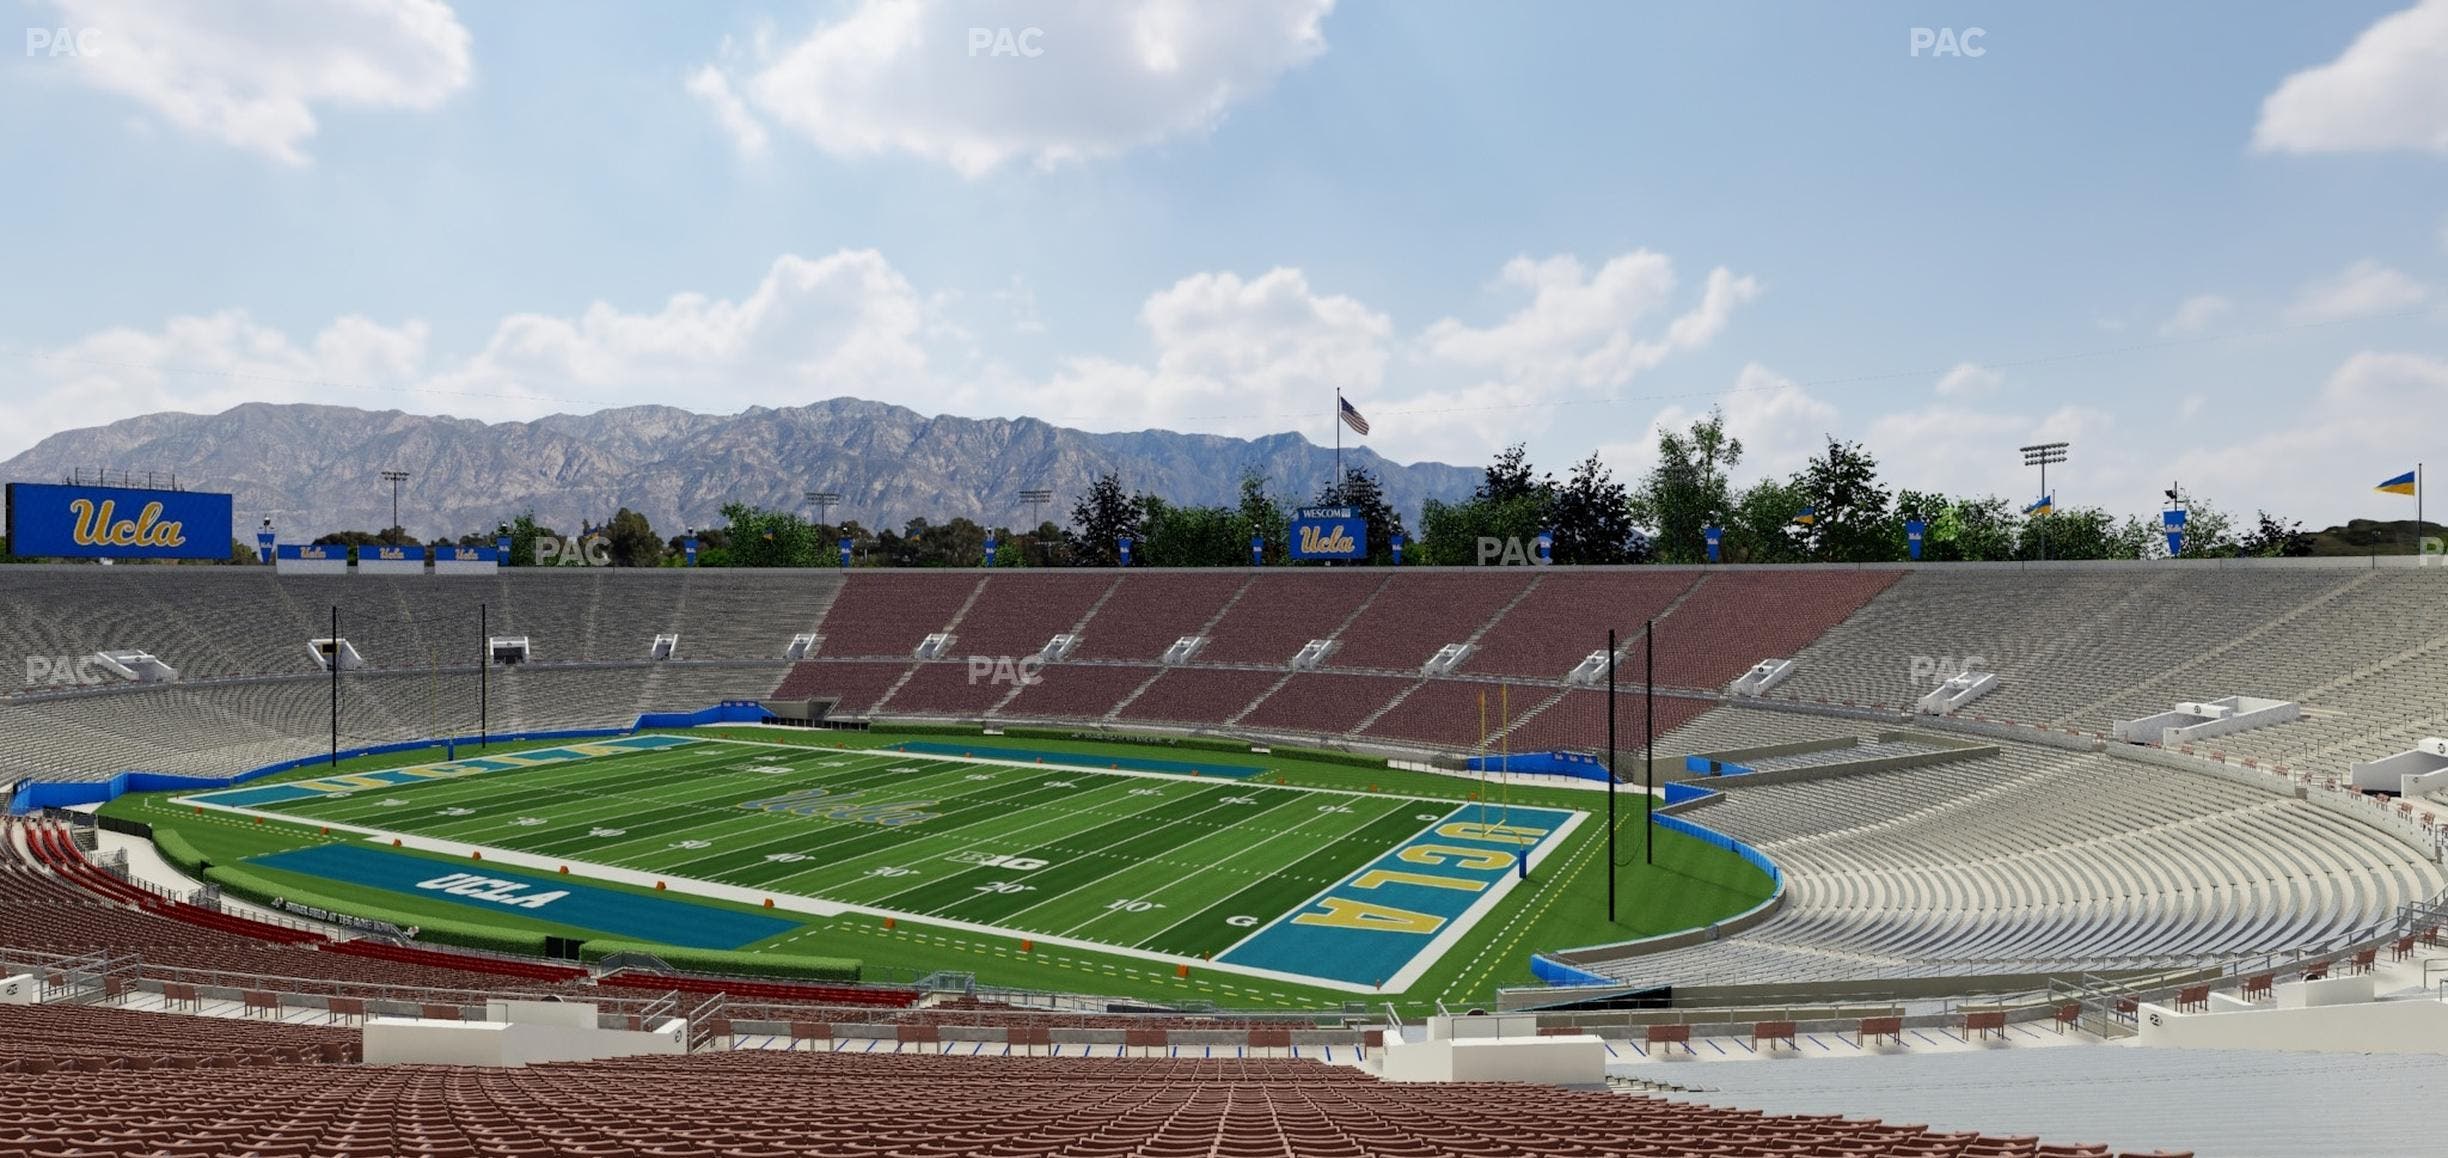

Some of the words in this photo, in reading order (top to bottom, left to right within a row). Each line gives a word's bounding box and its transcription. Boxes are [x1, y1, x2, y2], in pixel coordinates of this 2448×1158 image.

[70, 499, 186, 547] Ucla
[1303, 508, 1341, 519] WESCOM
[1300, 525, 1355, 553] Ucla
[1290, 821, 1549, 934] UCLA
[415, 872, 571, 909] UCLA
[974, 882, 1025, 894] 20
[1104, 899, 1153, 912] 10
[1226, 915, 1258, 927] G
